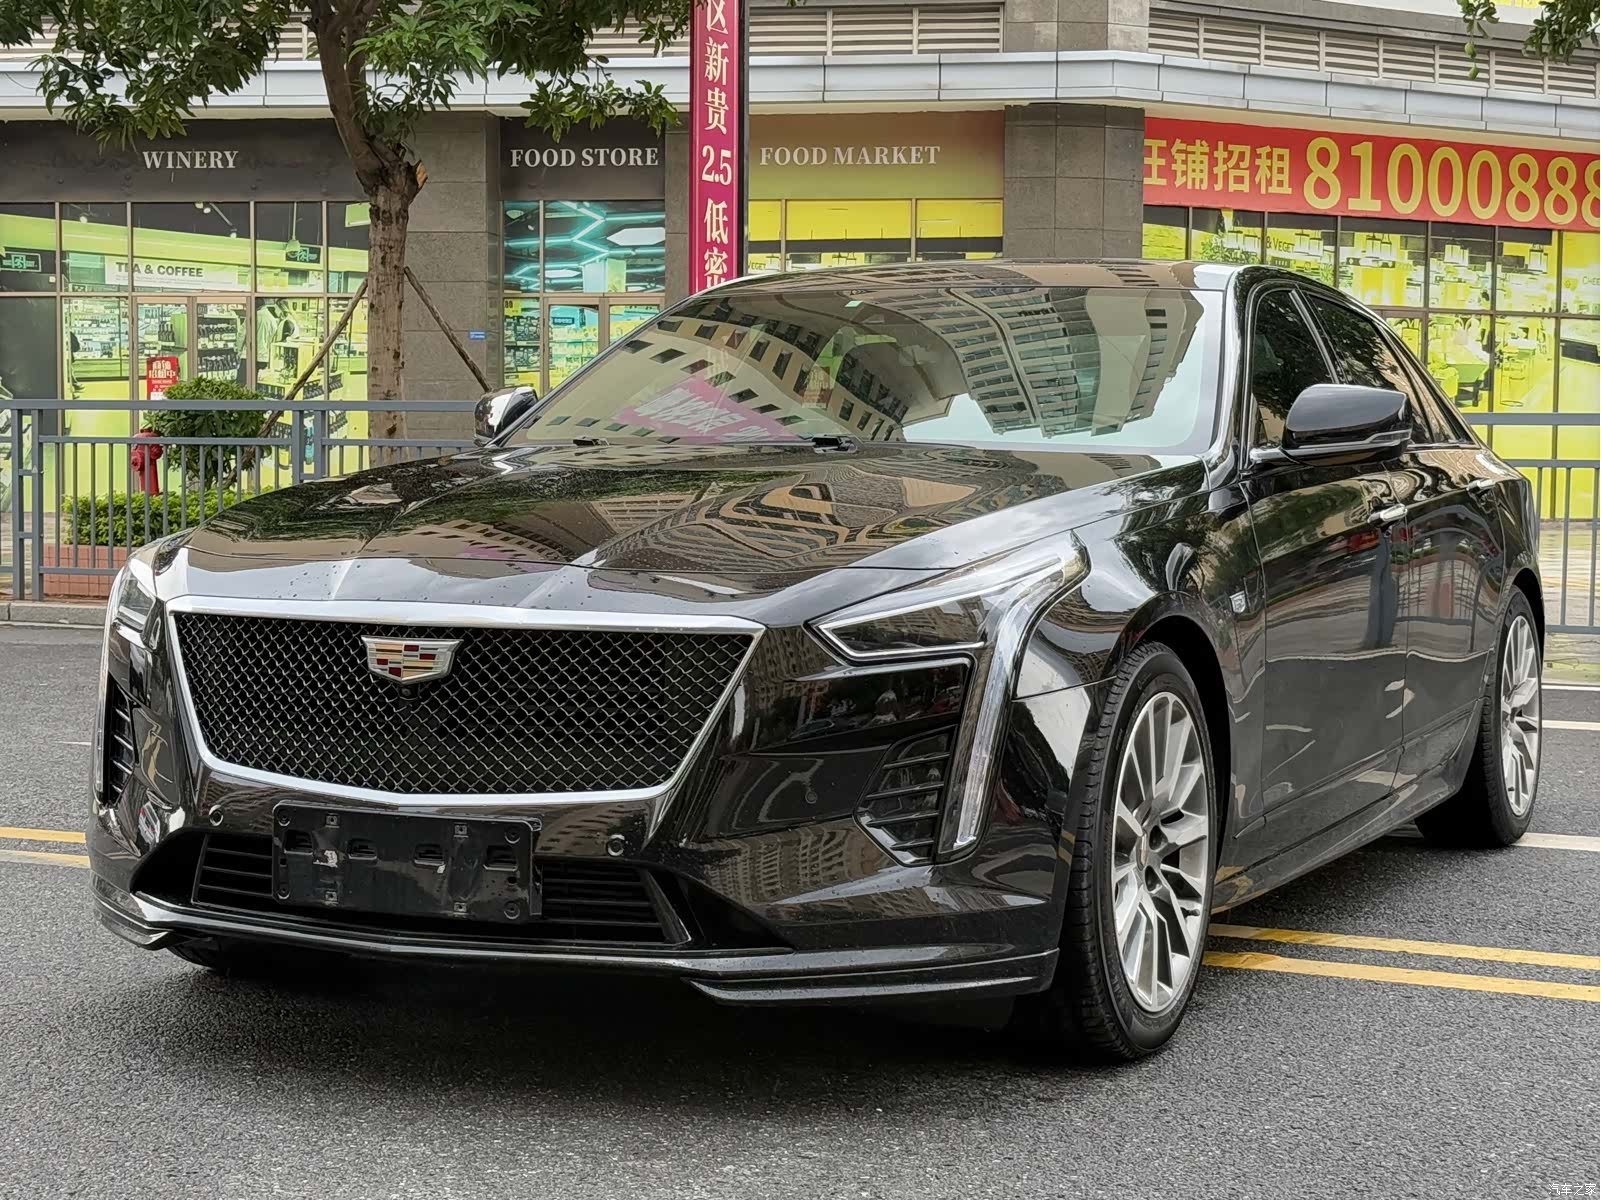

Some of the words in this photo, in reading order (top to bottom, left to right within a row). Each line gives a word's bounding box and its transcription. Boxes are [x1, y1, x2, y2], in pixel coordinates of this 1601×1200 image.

[142, 150, 239, 169] WINERY
[510, 148, 576, 167] FOOD
[581, 147, 659, 166] STORE
[701, 145, 732, 186] 2.5
[759, 146, 827, 166] FOOD
[833, 145, 941, 165] MARKET
[1303, 136, 1600, 228] 81000888
[703, 197, 729, 290] 低密
[144, 264, 154, 275] &
[157, 264, 204, 278] COFFEE
